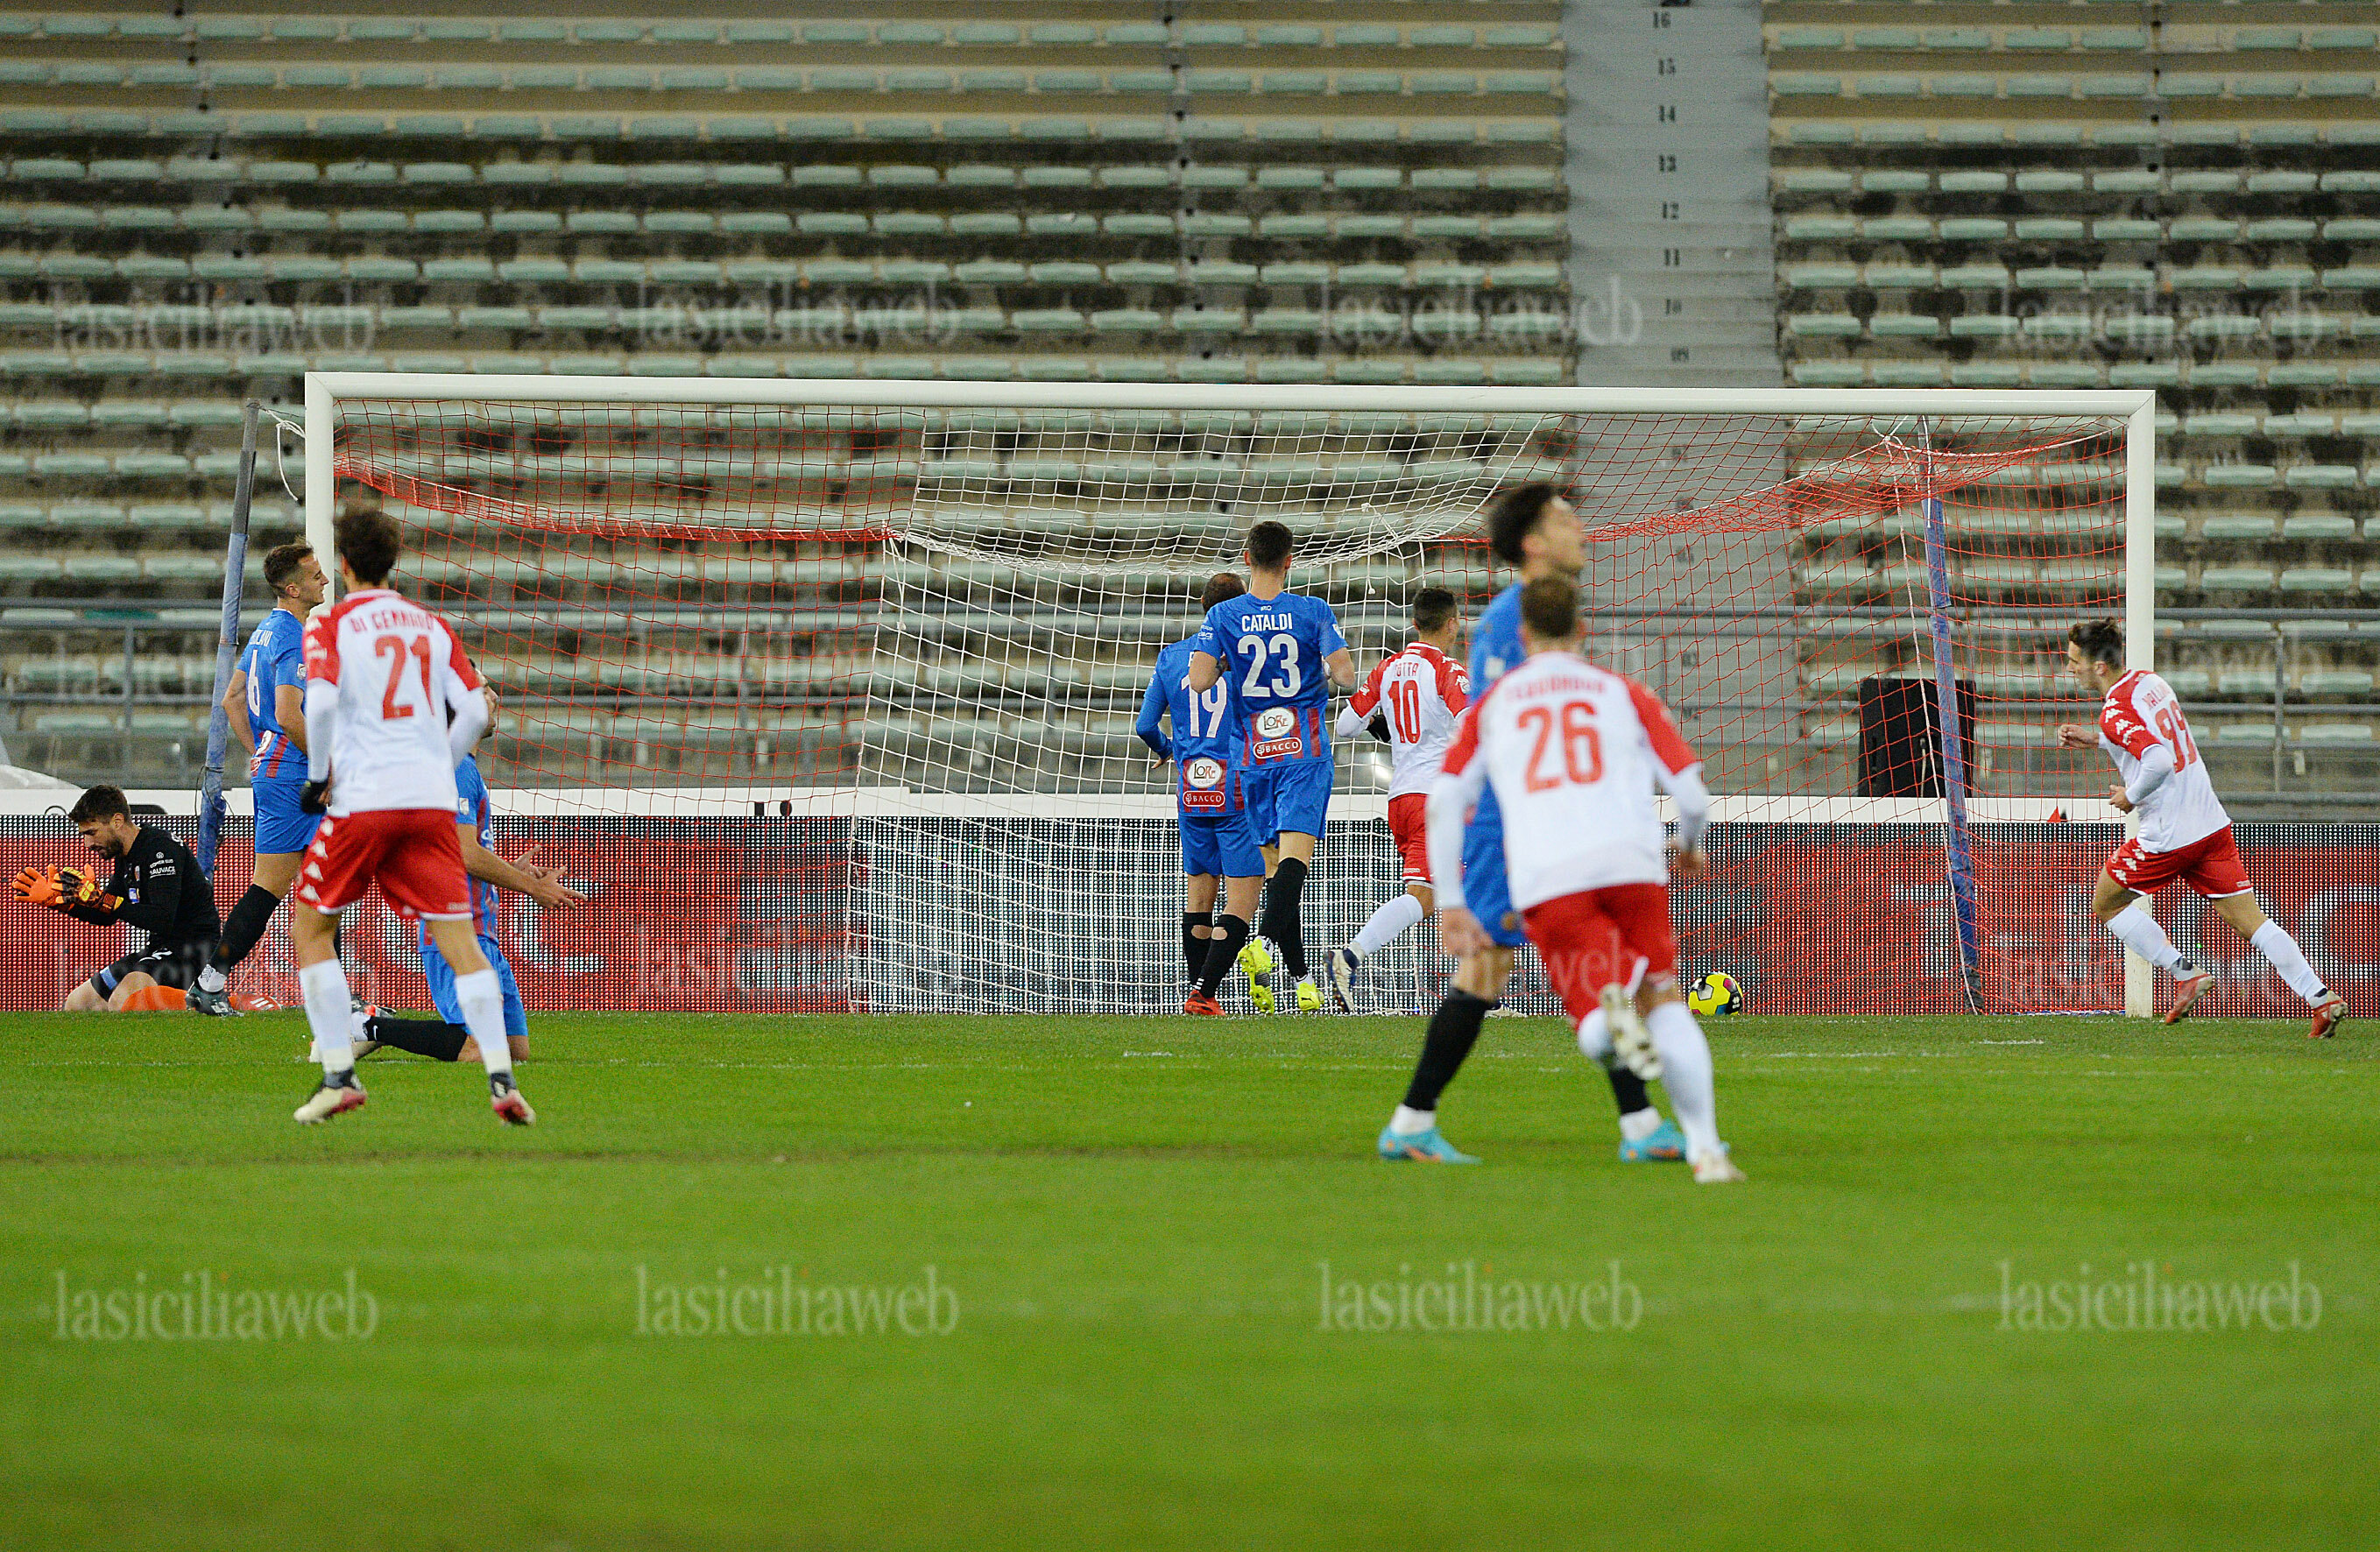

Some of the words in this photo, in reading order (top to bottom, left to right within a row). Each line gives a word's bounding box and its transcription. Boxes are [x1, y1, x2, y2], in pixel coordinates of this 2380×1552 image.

[1653, 11, 1672, 29] 16
[1658, 57, 1677, 76] 15
[1659, 104, 1677, 123] 14
[1659, 154, 1678, 173] 13
[1662, 201, 1681, 221] 12
[1664, 248, 1682, 267] 11
[1241, 613, 1293, 632] CATALDI
[1237, 633, 1302, 698] 23
[248, 649, 260, 717] 6
[375, 634, 436, 721] 21
[1181, 674, 1227, 738] 19
[1388, 680, 1421, 744] 10
[1516, 701, 1603, 794] 26
